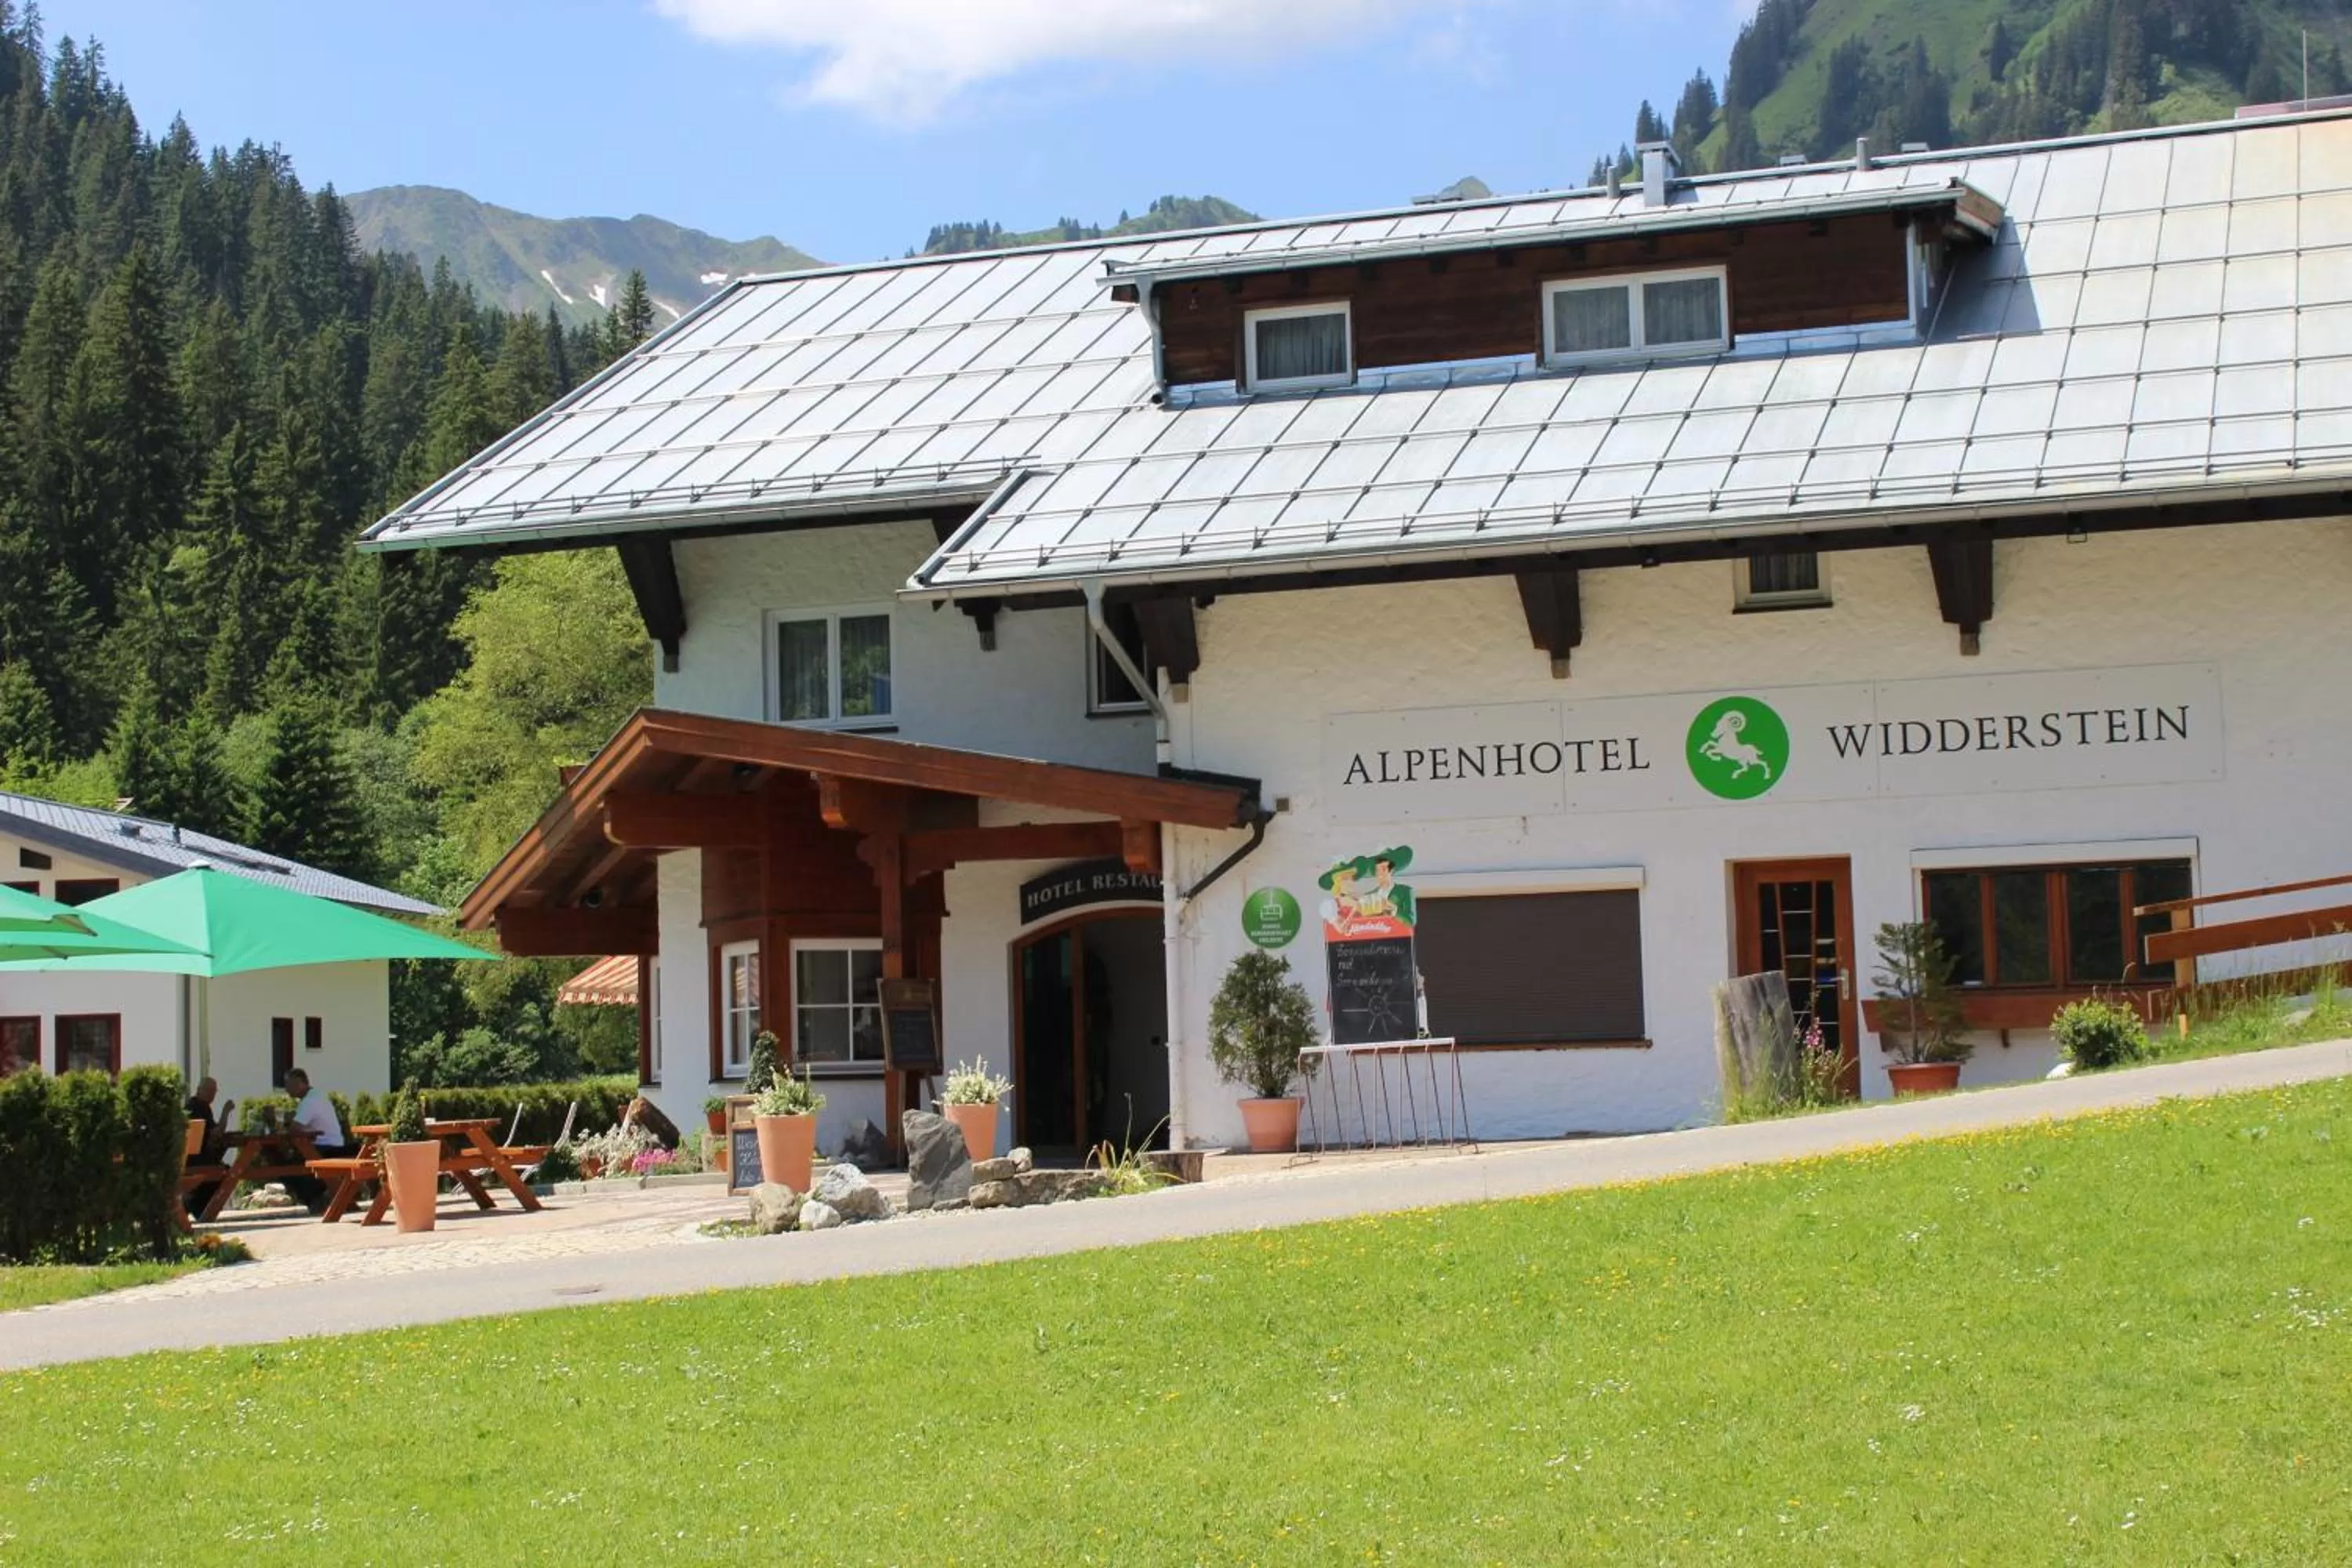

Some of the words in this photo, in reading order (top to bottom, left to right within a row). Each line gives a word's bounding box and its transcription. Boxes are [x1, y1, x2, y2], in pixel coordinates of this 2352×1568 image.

[1343, 738, 1650, 785] ALPENHOTEL
[1827, 706, 2190, 758] WIDDERSTEIN
[1027, 878, 1086, 908] HOTEL
